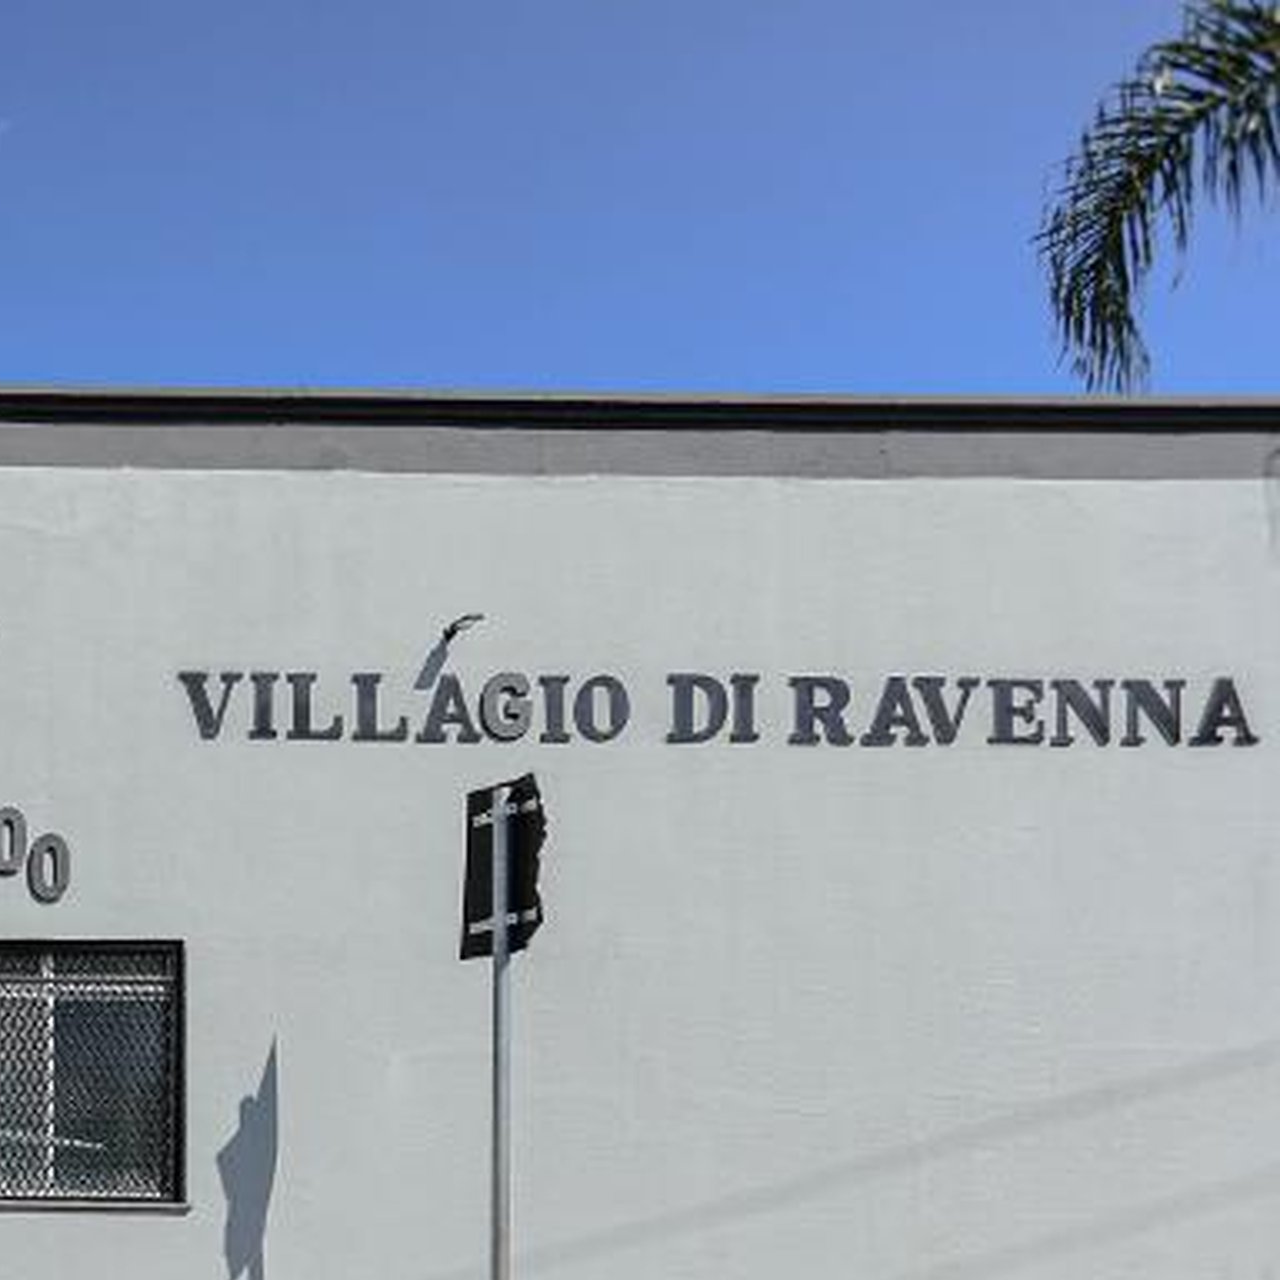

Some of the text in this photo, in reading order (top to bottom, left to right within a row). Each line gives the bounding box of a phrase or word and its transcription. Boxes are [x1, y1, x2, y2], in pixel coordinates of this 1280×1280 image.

[178, 670, 1259, 749] VILLAGIO DI RAVENNA
